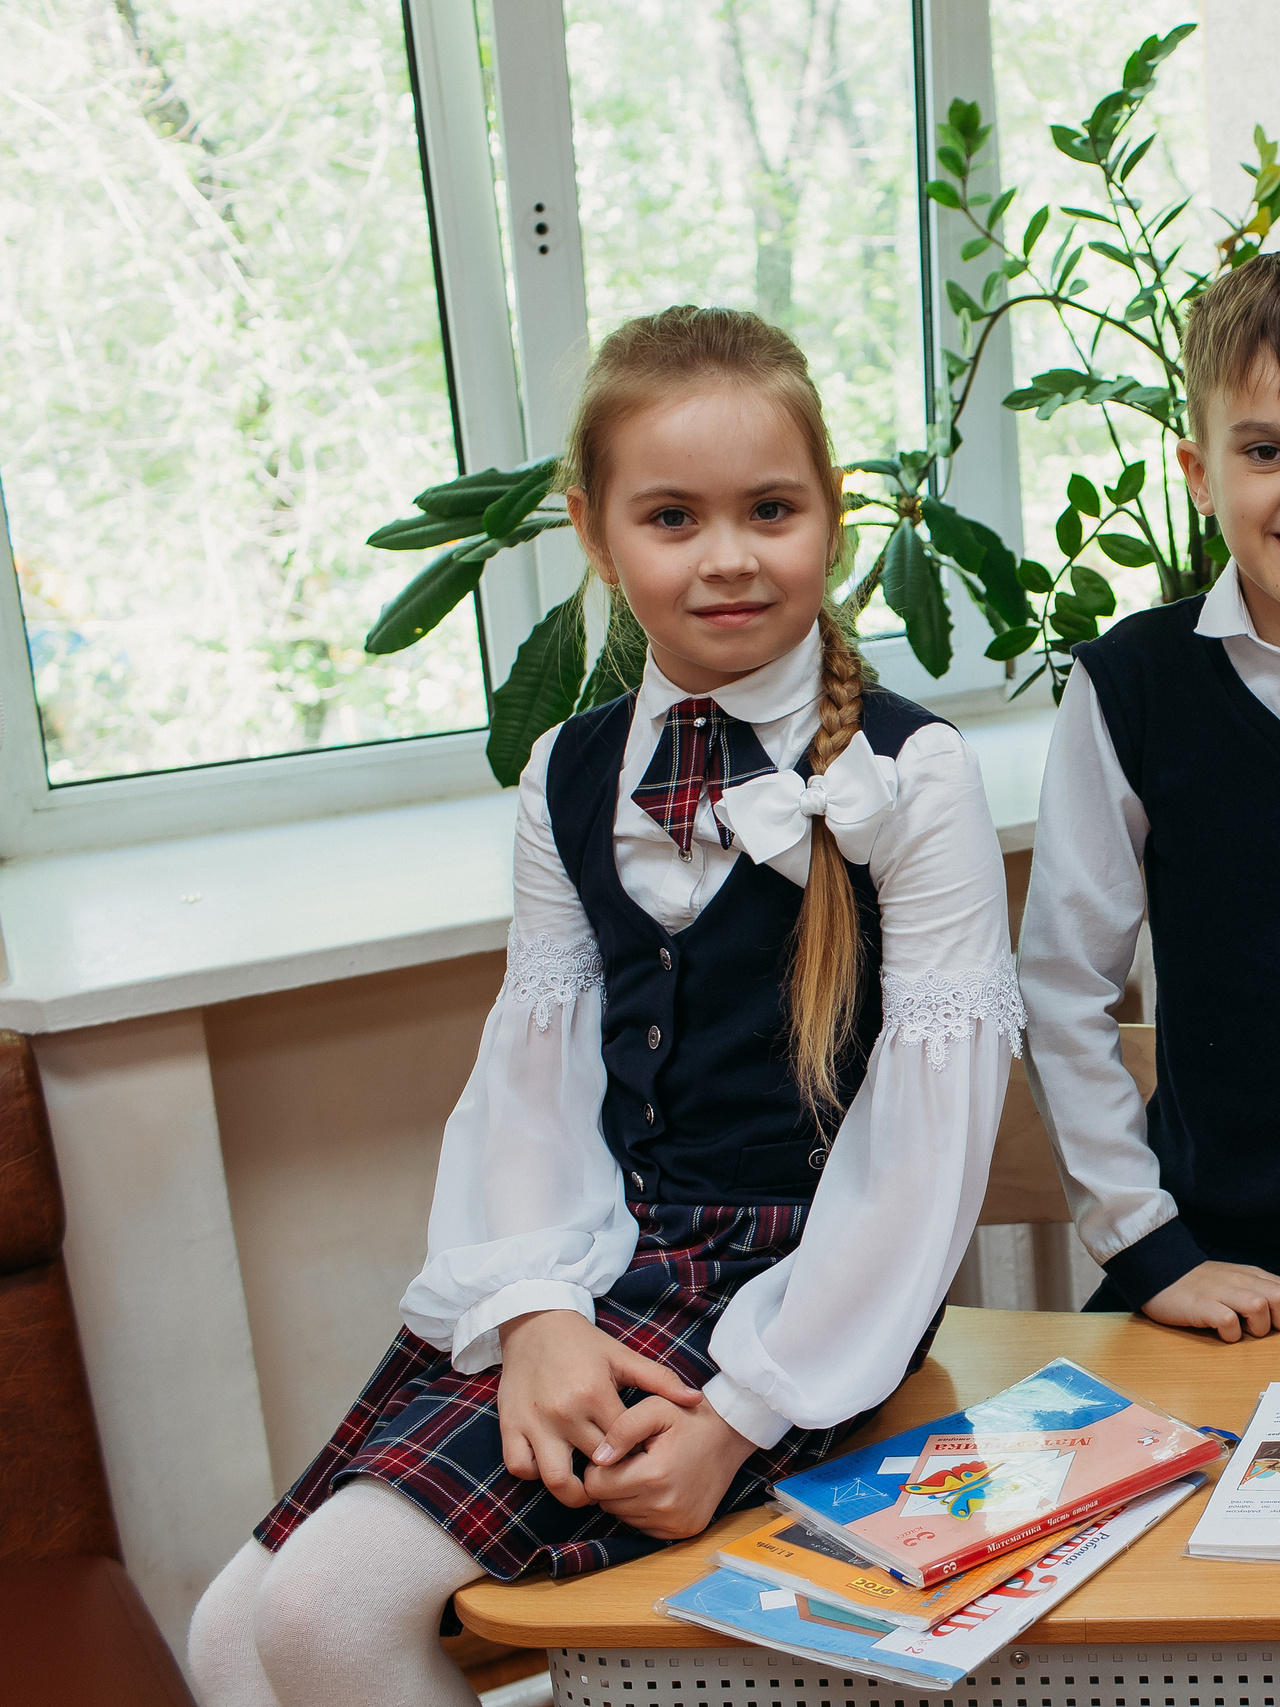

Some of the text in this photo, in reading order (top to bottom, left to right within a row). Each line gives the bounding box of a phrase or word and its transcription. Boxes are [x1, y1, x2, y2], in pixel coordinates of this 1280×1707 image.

[893, 1526, 923, 1540] класс
[903, 1531, 936, 1547] 3
[943, 1500, 1099, 1574] 3 Математика Часть вторая
[756, 1541, 779, 1553] Голубь
[1062, 1532, 1110, 1567] Рабочая
[854, 1579, 895, 1595] ФГОС
[905, 1645, 924, 1654] 2
